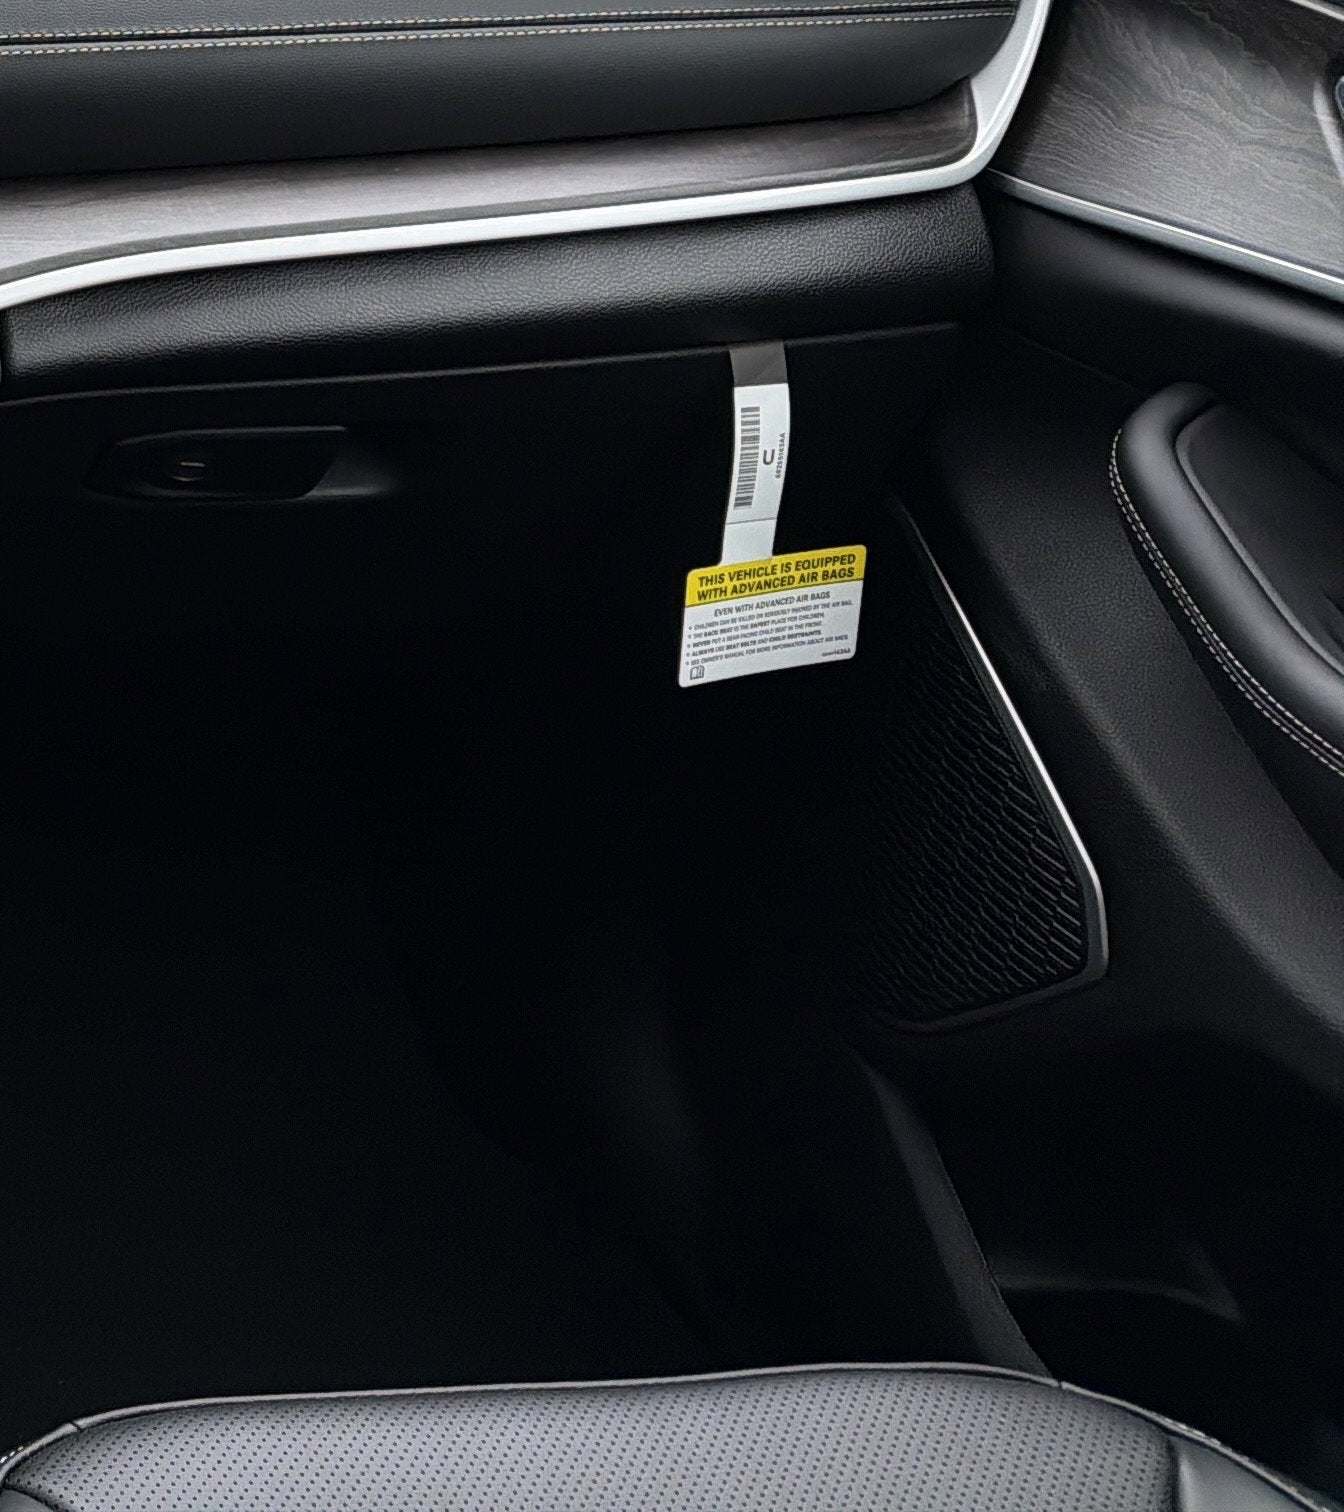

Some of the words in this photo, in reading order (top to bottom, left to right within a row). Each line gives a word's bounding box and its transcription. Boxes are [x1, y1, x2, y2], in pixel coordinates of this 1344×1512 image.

[697, 586, 729, 602] WITH
[731, 576, 795, 595] ADVANCED
[798, 571, 819, 585] AIR
[822, 567, 855, 581] BAGS
[698, 573, 725, 588] THIS
[729, 564, 778, 583] VEHICLE
[781, 561, 792, 574] IS
[795, 553, 856, 572] EQUIPPED
[714, 607, 734, 617] EVEN
[735, 603, 754, 614] WITH
[755, 596, 795, 610] ADVANCED
[796, 594, 809, 603] AIR
[811, 591, 831, 600] BAGS
